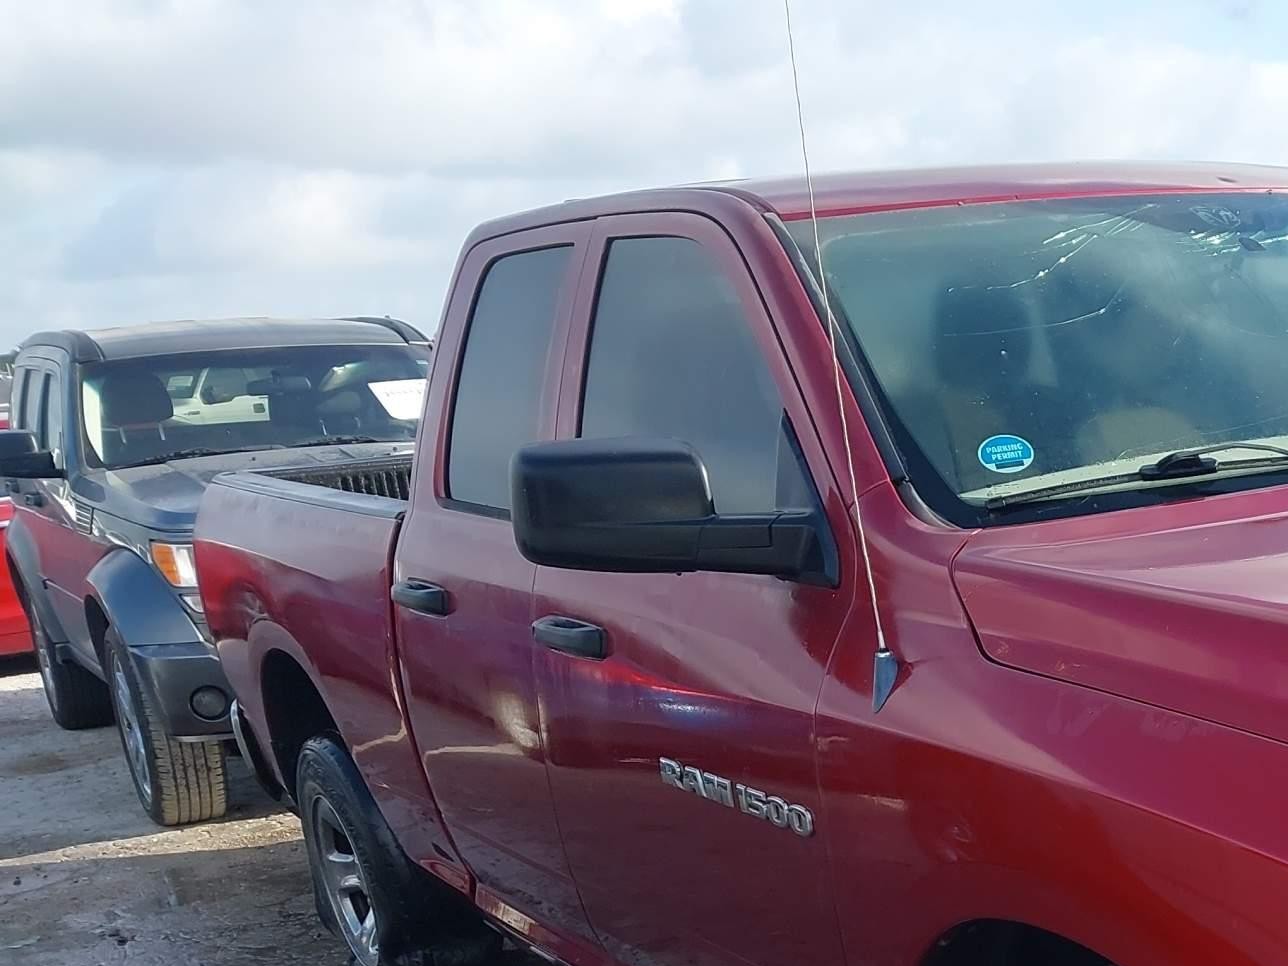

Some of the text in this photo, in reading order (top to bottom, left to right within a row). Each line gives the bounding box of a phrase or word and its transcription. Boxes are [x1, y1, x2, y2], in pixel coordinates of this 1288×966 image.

[986, 443, 1023, 453] PARKING
[992, 451, 1022, 460] PERMIT
[659, 756, 814, 838] RAM 1500
